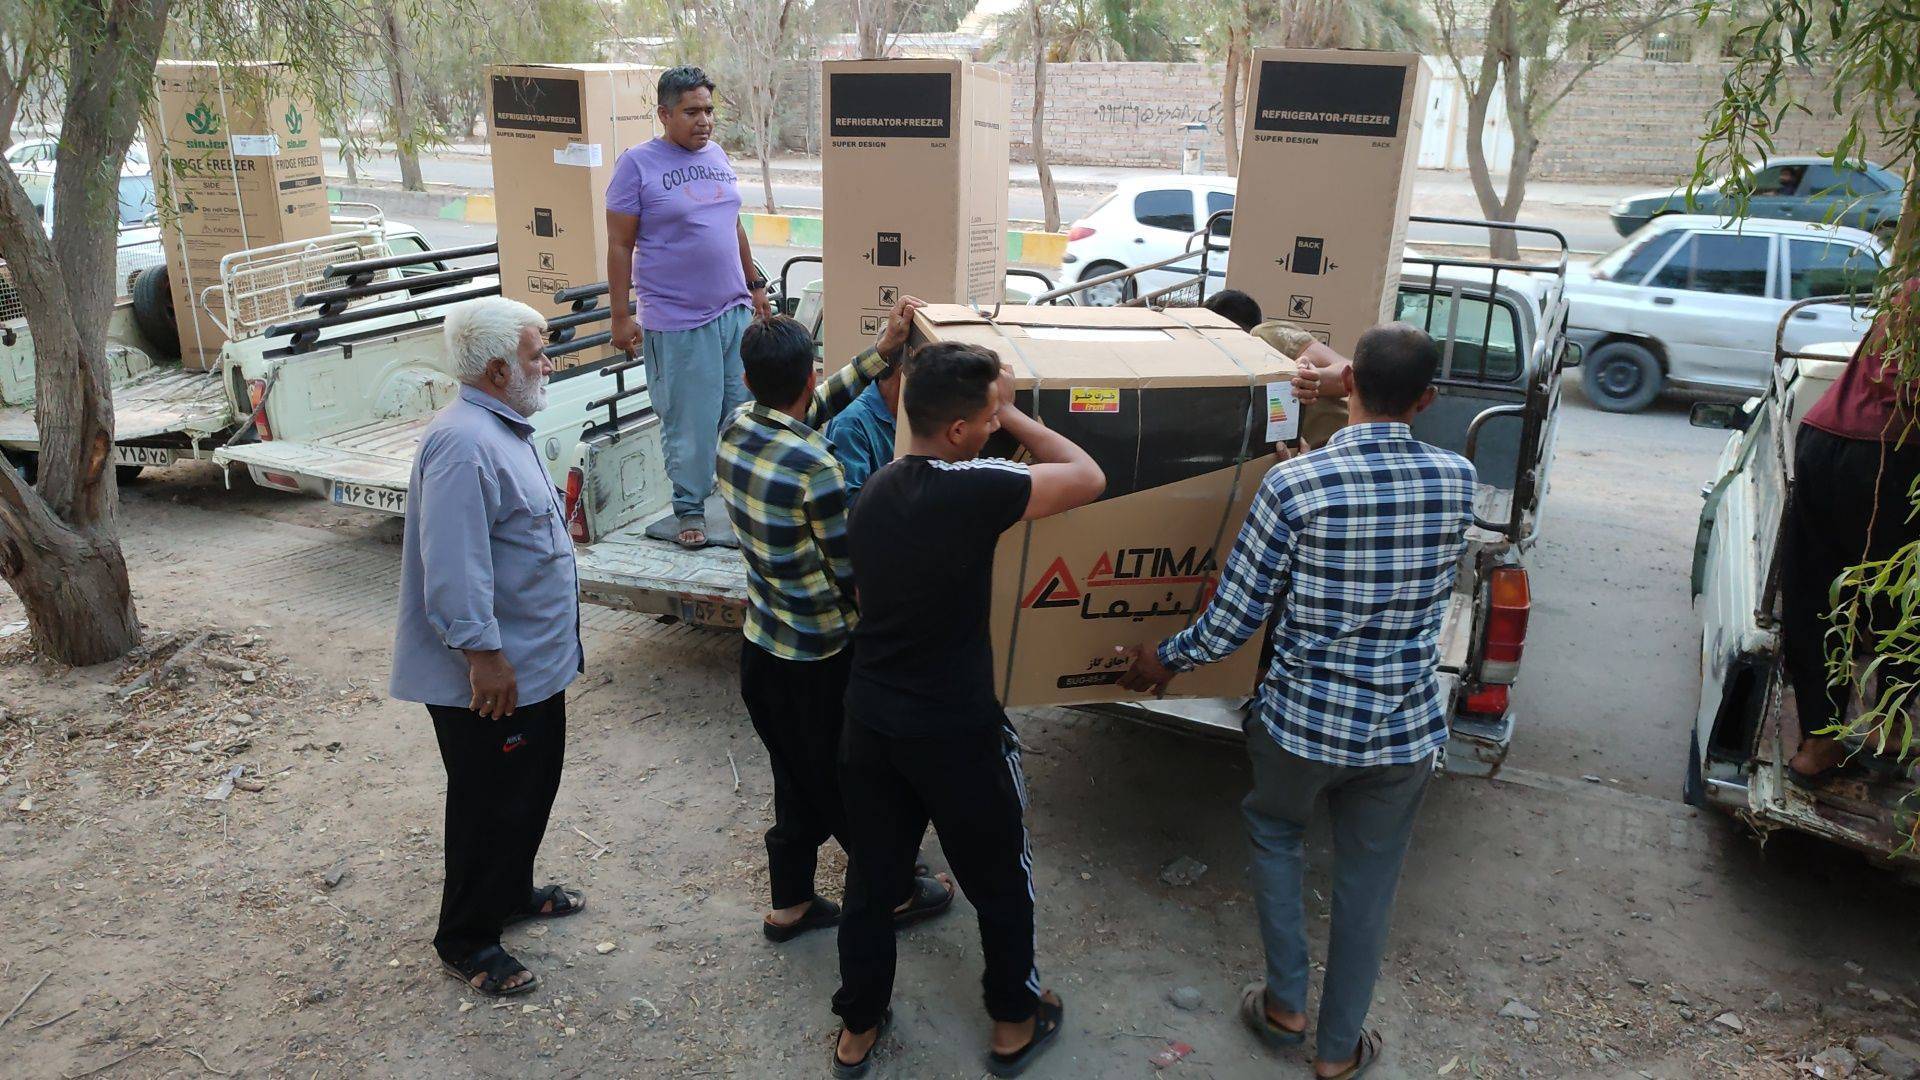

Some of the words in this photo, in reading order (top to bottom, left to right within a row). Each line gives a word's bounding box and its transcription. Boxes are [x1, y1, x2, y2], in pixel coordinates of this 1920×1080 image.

[497, 112, 577, 125] REFRIGERATOR-FREEZER
[835, 117, 944, 128] REFRIGERATOR-FREEZER
[1261, 109, 1390, 125] REFRIGERATOR-FREEZER
[1254, 134, 1283, 143] SUPER
[1285, 136, 1319, 145] DESIGN
[1371, 141, 1391, 149] BACK
[276, 158, 298, 170] FRIDGE
[1297, 240, 1321, 249] BACK
[1087, 546, 1218, 580] ALTIMA
